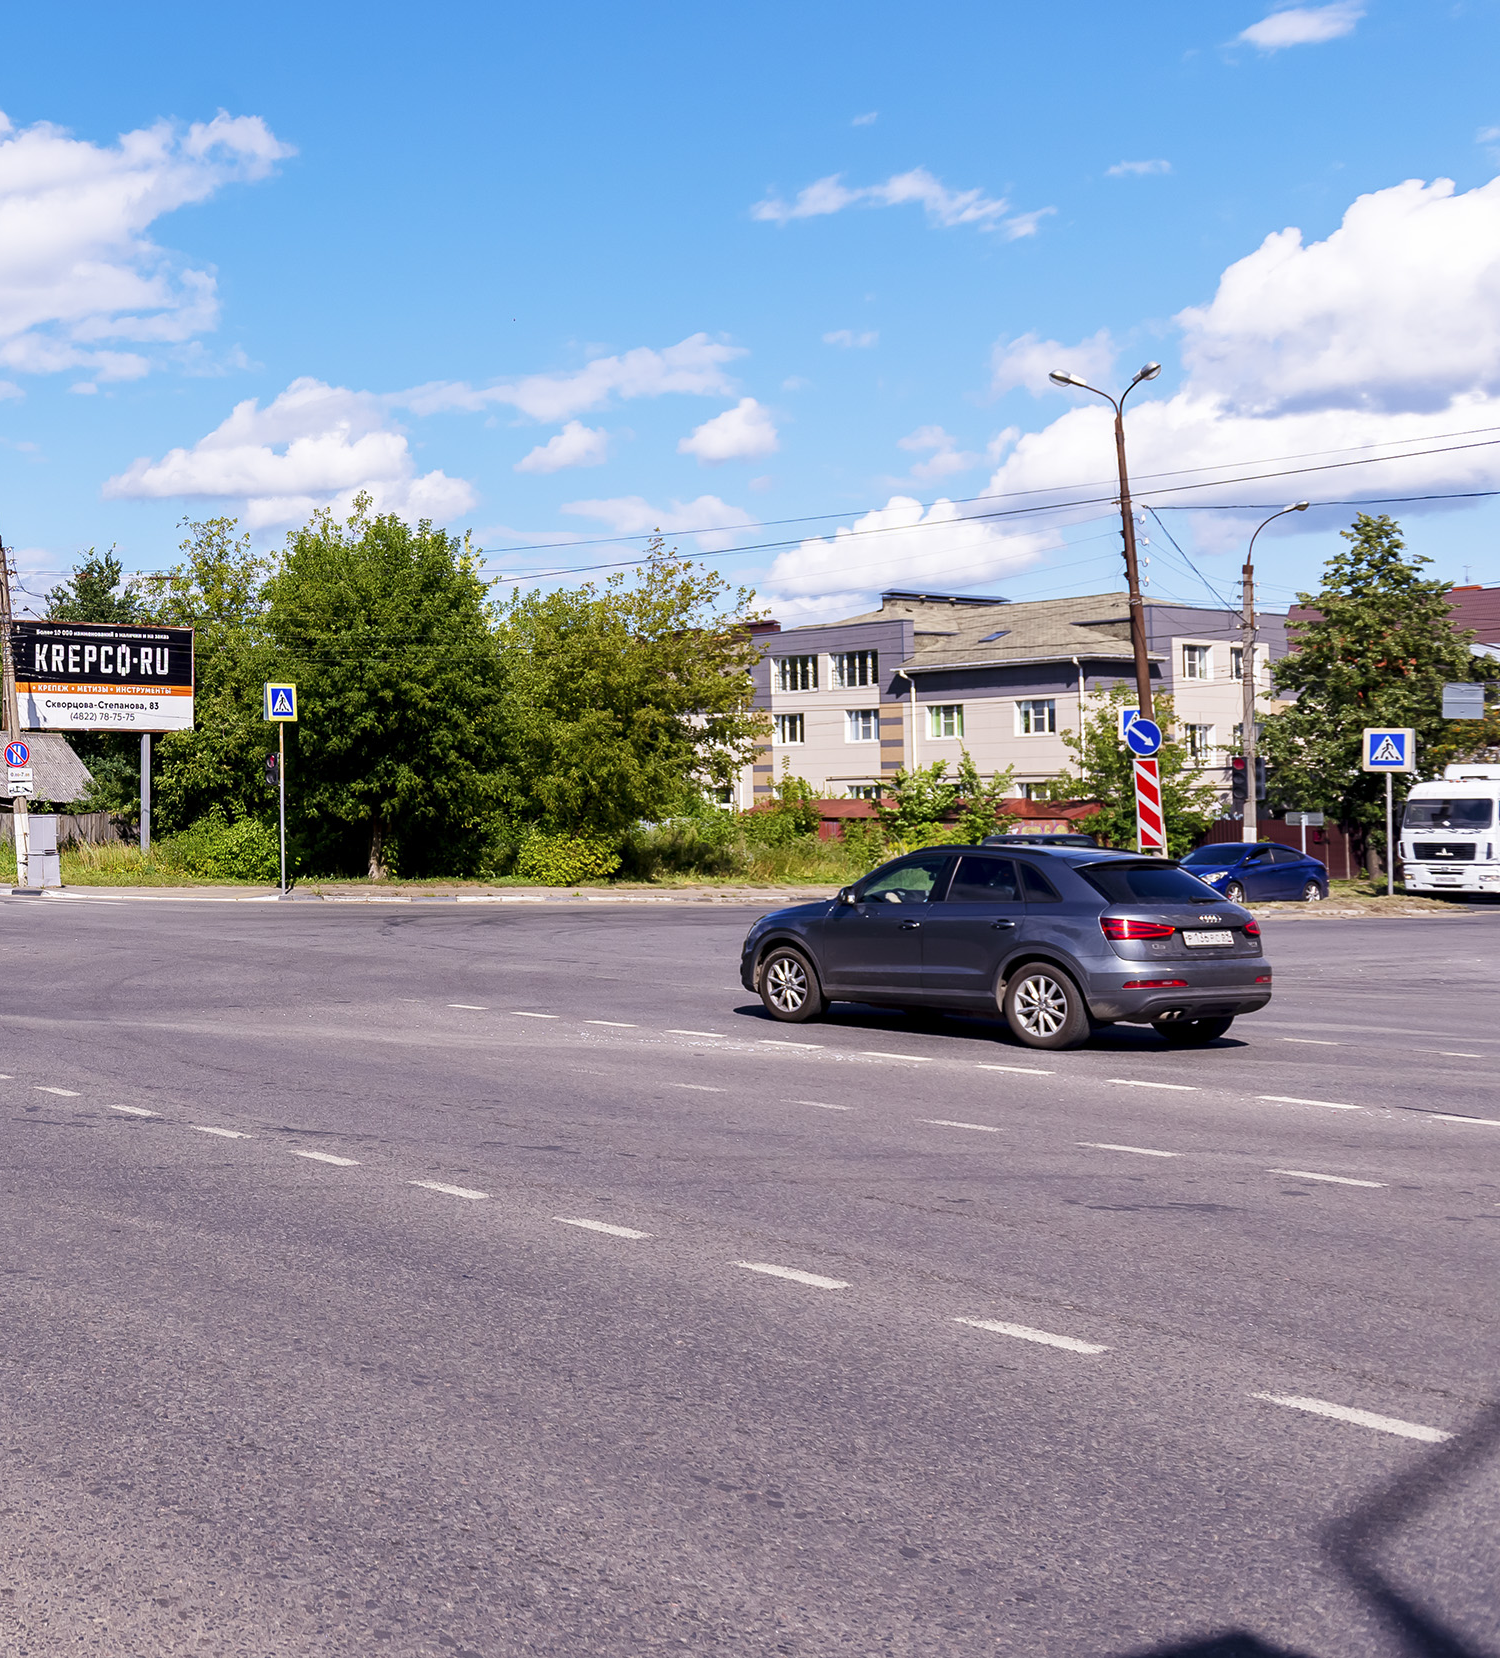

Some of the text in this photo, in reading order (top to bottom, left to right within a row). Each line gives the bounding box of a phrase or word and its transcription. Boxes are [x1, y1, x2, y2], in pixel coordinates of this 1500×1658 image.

[38, 684, 172, 694] КРЕПЕЖ МЕТИЗЫ ИНСТРУМЕНТЫ
[45, 699, 159, 711] Скворцова-Степанова, 83
[70, 712, 135, 721] (4822) 78-75-75
